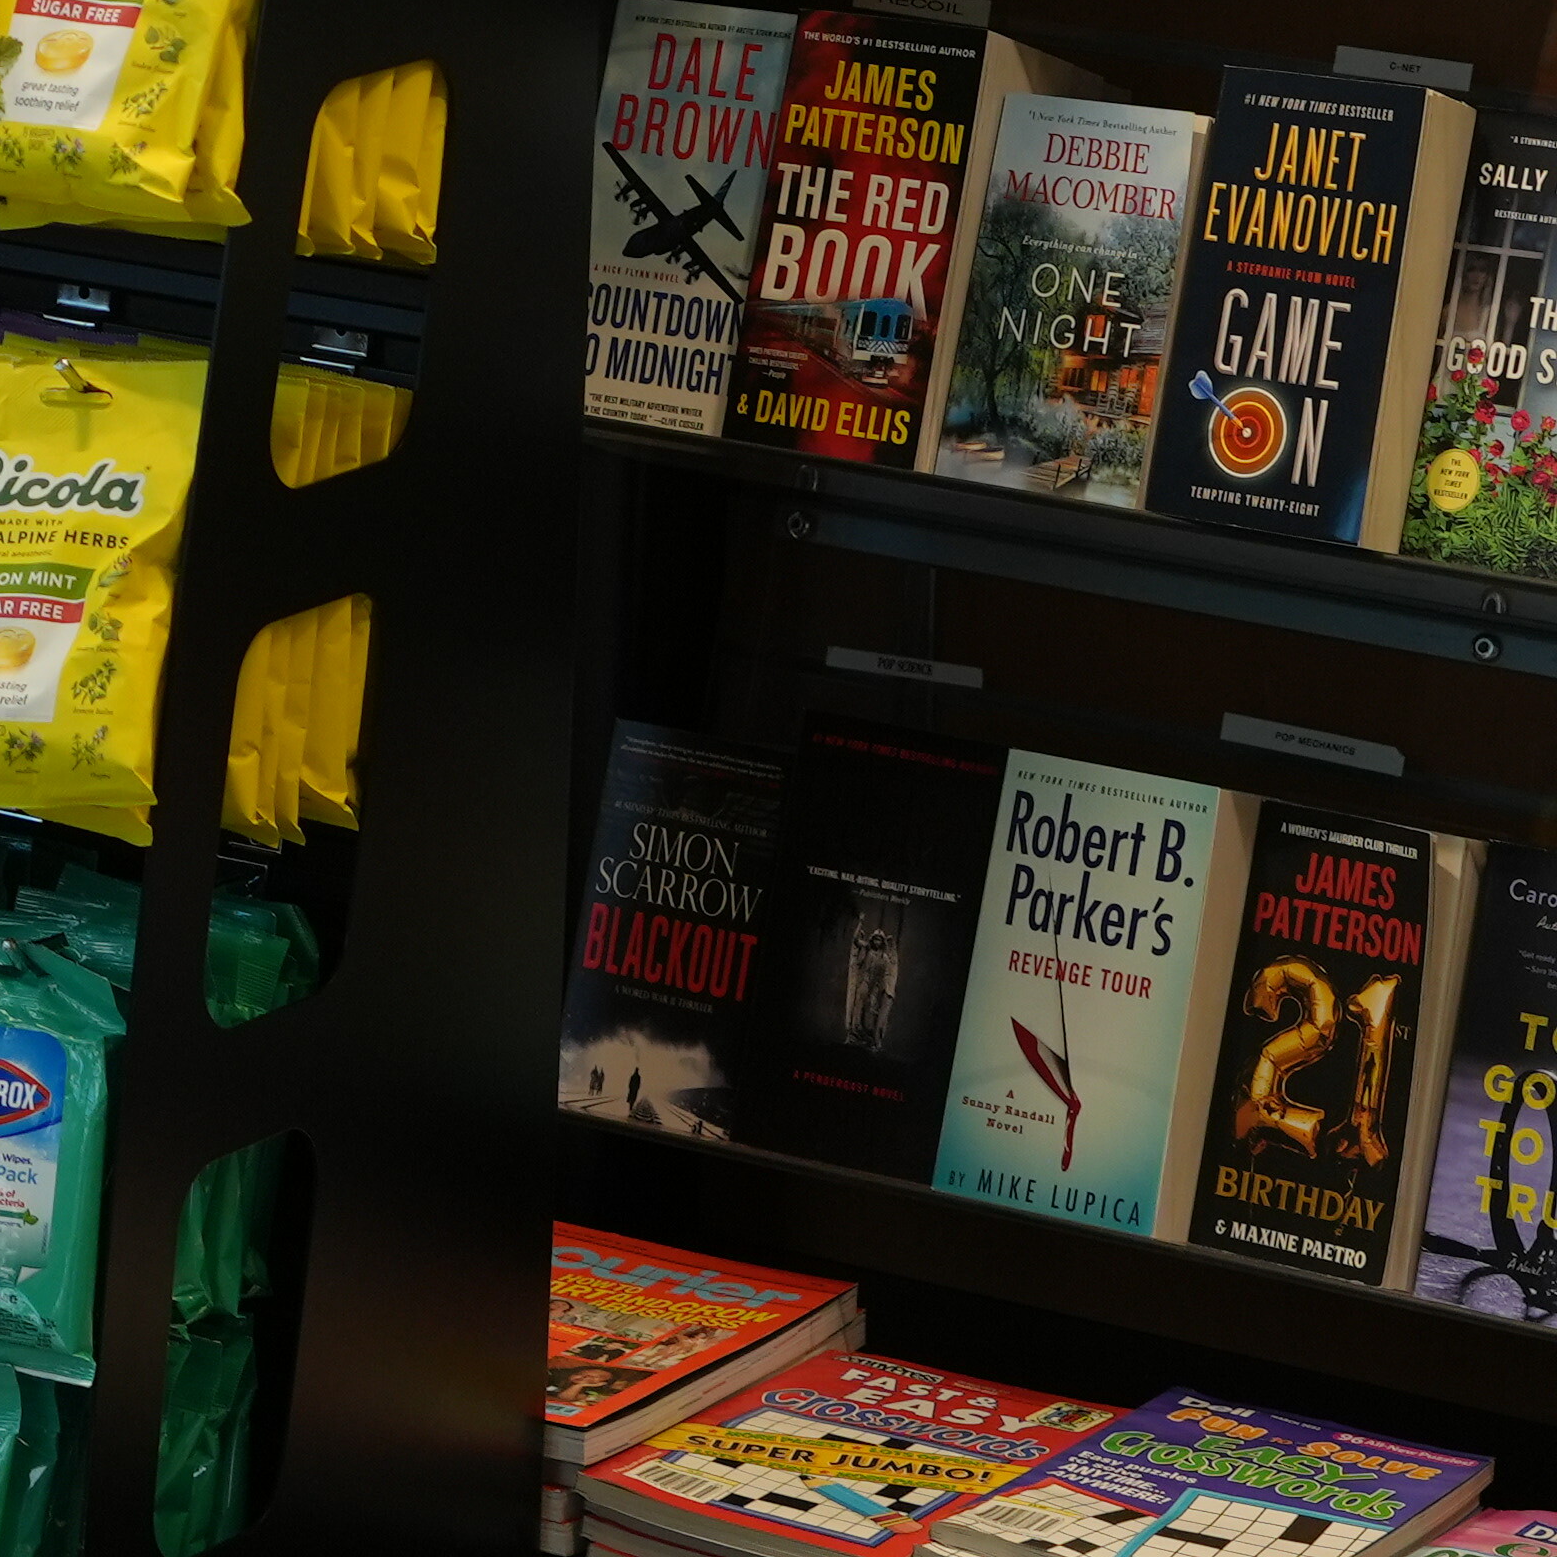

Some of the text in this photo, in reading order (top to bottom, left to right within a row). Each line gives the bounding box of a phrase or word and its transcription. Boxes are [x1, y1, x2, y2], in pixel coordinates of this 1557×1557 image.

[824, 59, 937, 112] JAMES
[1389, 61, 1422, 74] C-NET
[784, 103, 966, 167] PATTERSON
[1044, 131, 1151, 176] DEBBIE
[1254, 123, 1367, 190] JANET
[1004, 169, 1178, 221] MACOMBER
[1204, 183, 1397, 264] EVANOVICH
[1006, 790, 1194, 888] Robert B.
[1006, 865, 1172, 956] Parker's
[686, 1435, 994, 1484] SUPER JUMBO!
